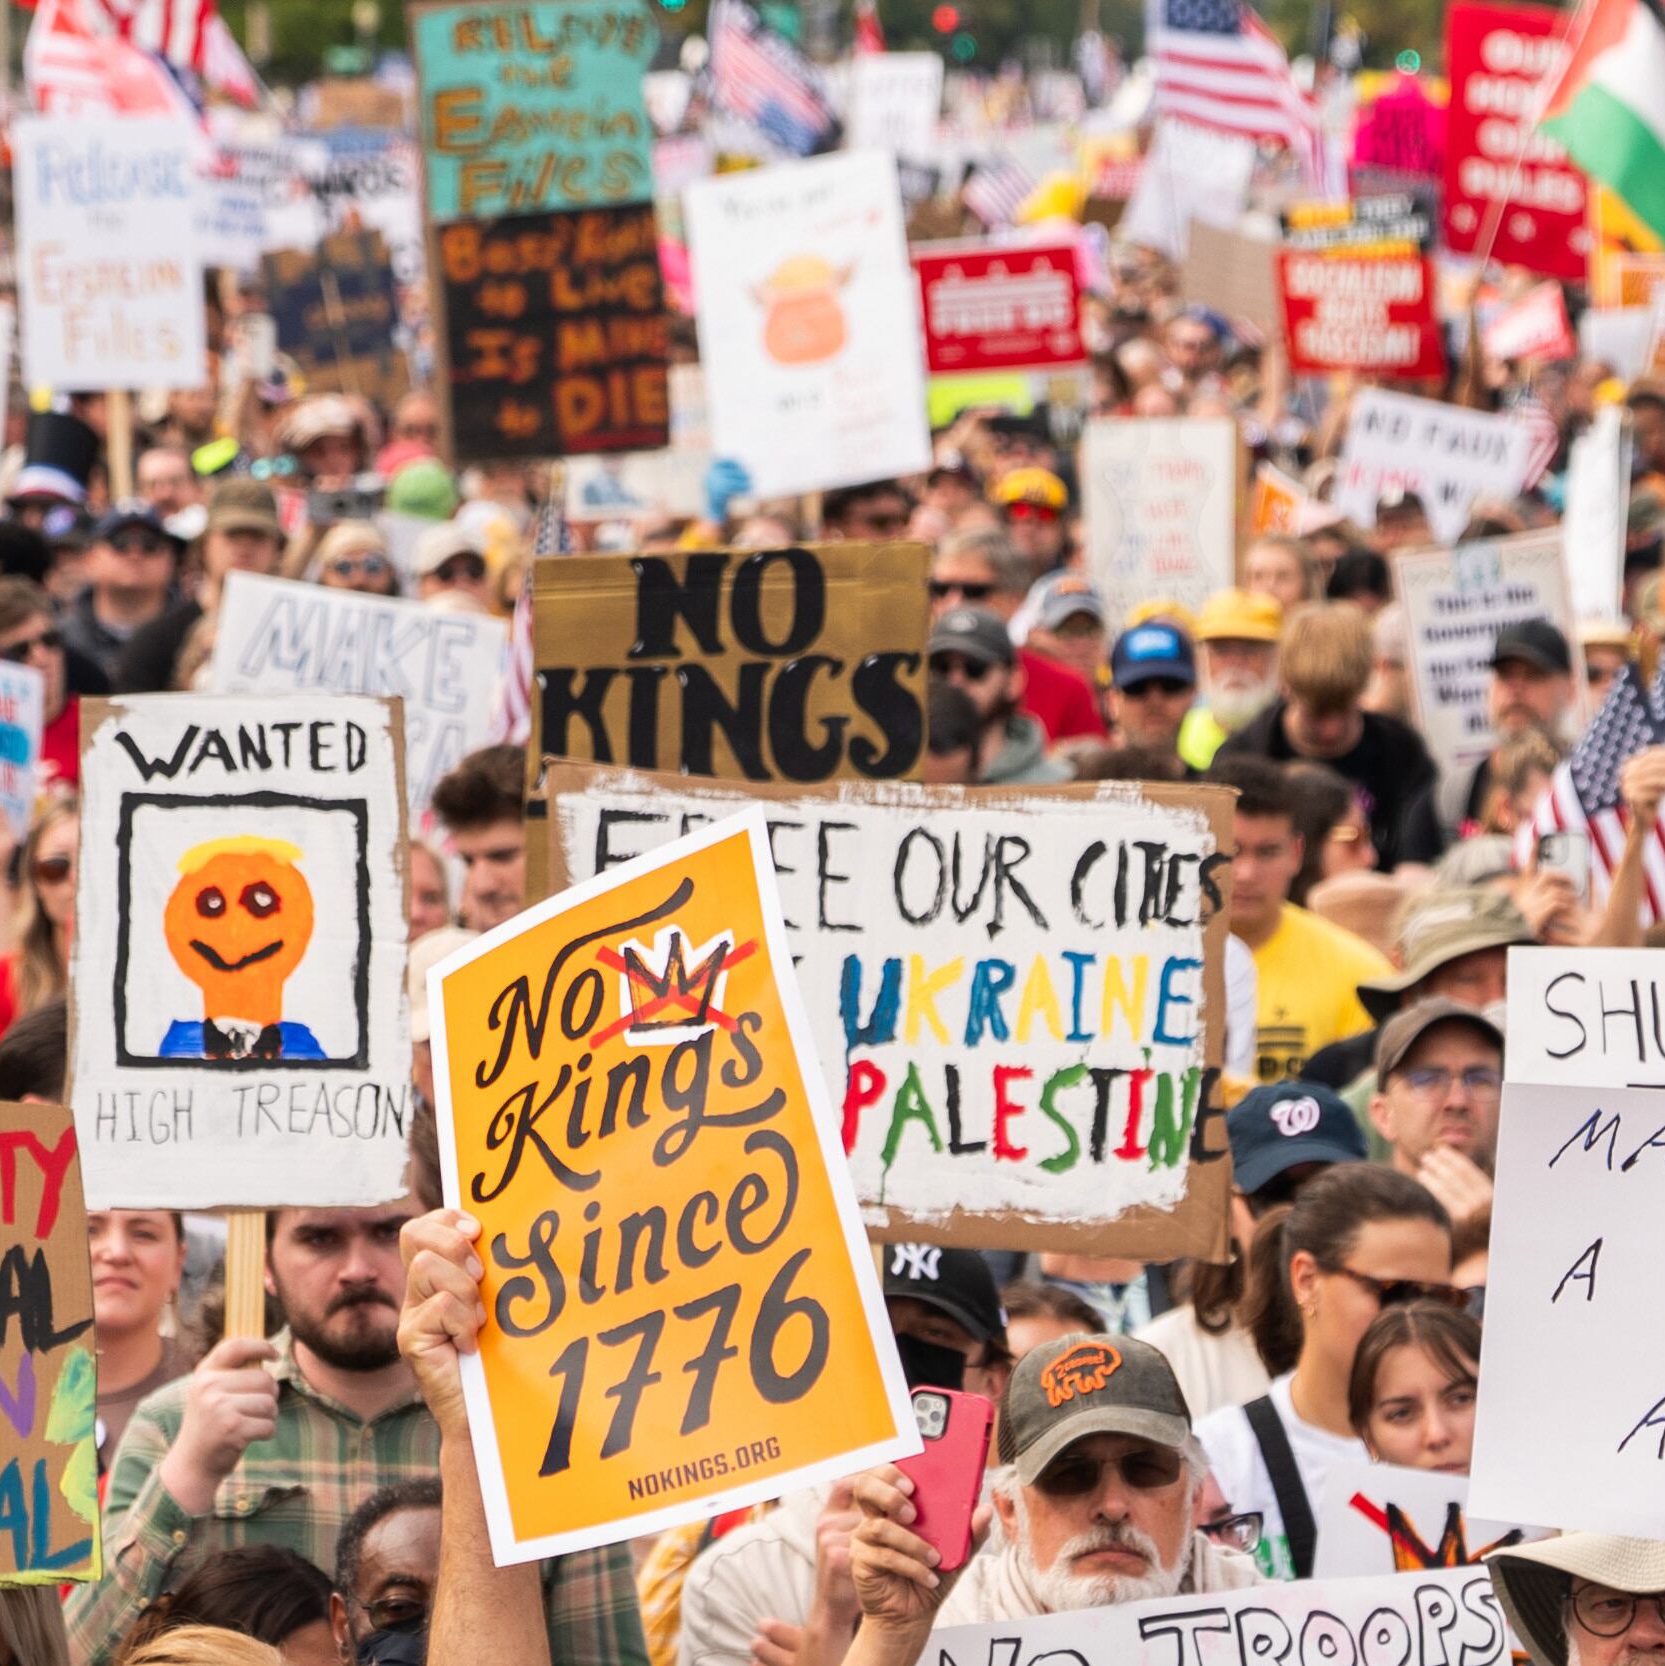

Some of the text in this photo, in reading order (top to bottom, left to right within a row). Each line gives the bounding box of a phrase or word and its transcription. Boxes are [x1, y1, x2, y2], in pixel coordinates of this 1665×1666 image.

[236, 594, 479, 714] MAKE
[627, 546, 828, 660] NO
[113, 718, 368, 784] WANTED
[535, 651, 926, 783] KINGS
[594, 808, 866, 933] FEE
[893, 826, 1050, 940] OUR
[475, 876, 696, 1090] No
[838, 949, 1206, 1052] UKRAINE
[94, 1080, 407, 1147] HIGH TREASON
[469, 1008, 787, 1204] Kings
[842, 1055, 1232, 1178] PALESTINE
[489, 1127, 799, 1338] Since
[1551, 1237, 1605, 1304] A
[537, 1247, 831, 1478] 1776
[627, 1437, 783, 1502] NOKINGS.ORG
